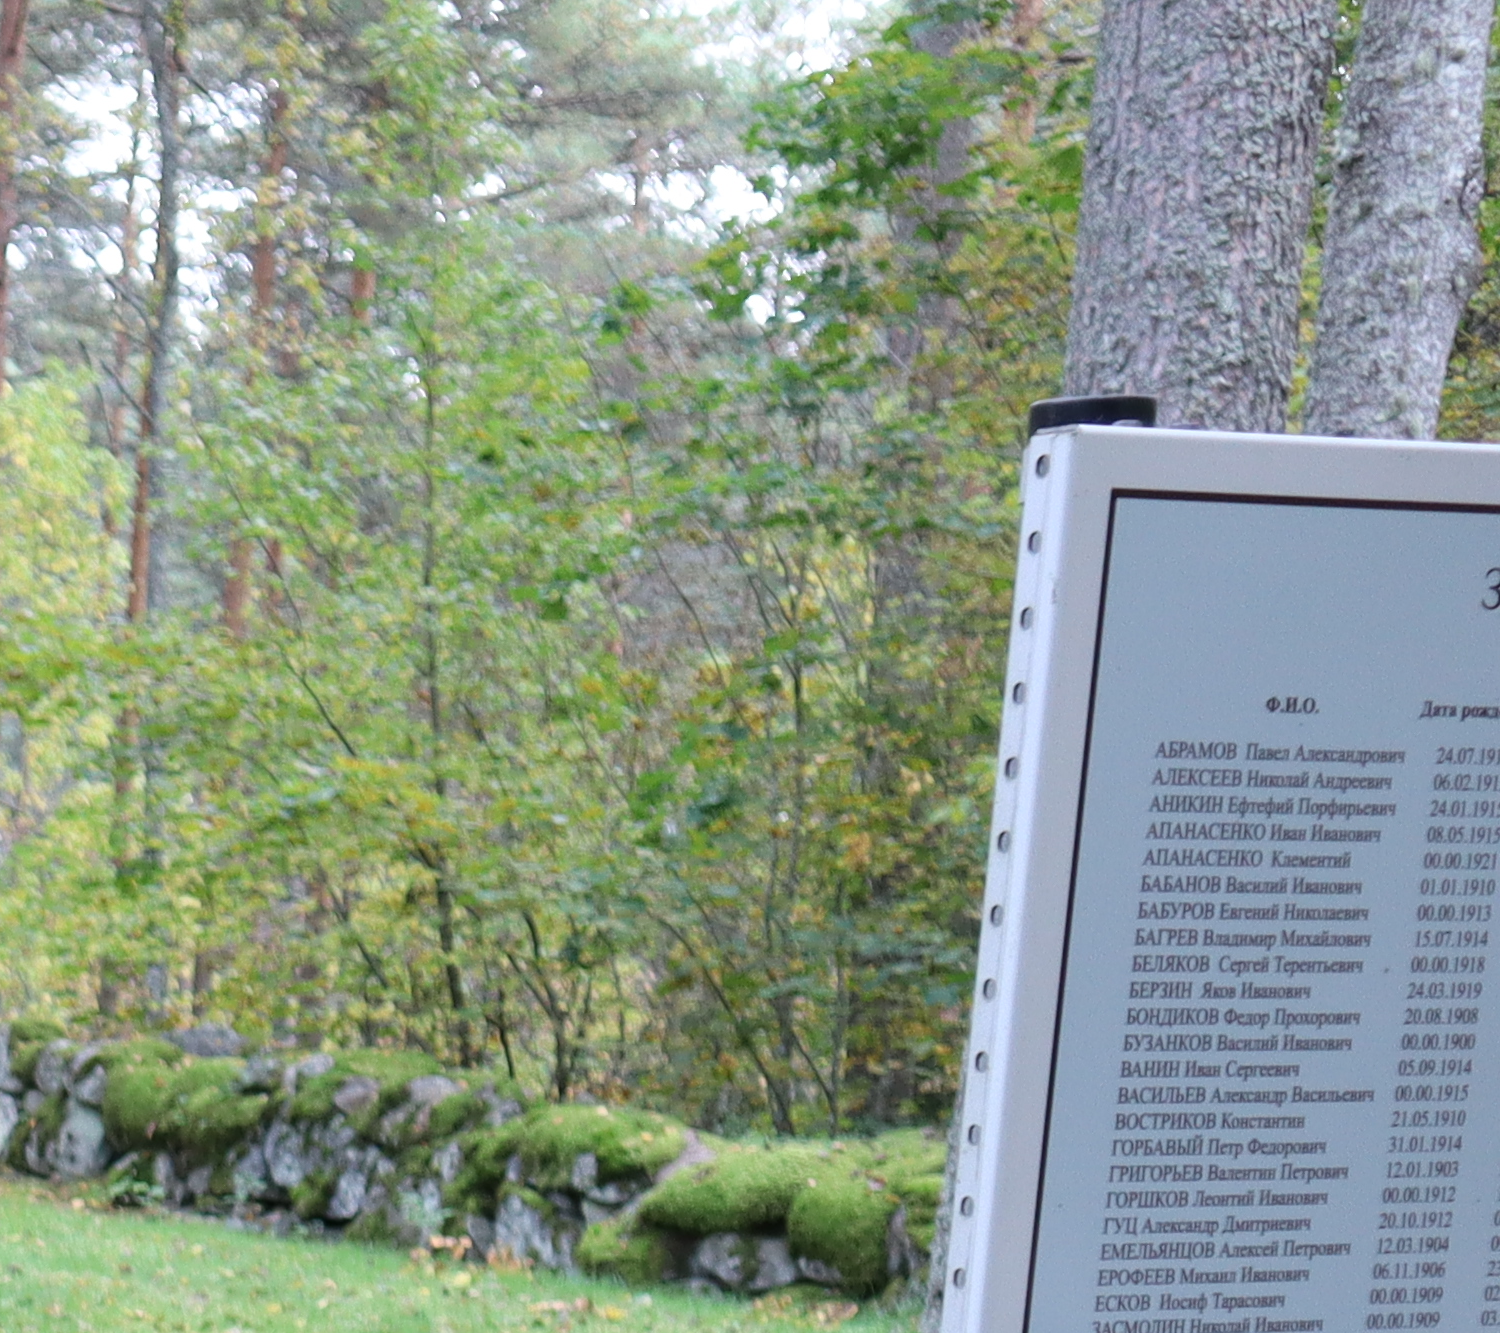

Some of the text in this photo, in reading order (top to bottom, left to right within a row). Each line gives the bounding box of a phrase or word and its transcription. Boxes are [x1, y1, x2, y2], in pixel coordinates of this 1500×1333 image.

[1266, 697, 1456, 719] Ф.И.О. Дата
[1155, 740, 1406, 768] АБРАМОВ Павел Александрович
[1152, 767, 1393, 794] АЛЕКСЕЕВ Николай Андреевич
[1149, 794, 1224, 813] АНИКИН
[1298, 797, 1397, 820] Порфирьевич
[1146, 821, 1267, 841] АПАНАСЕНКО
[1270, 824, 1307, 842] Иван
[1311, 824, 1382, 843] Иванович
[1142, 848, 1498, 871] АПАНАСЕНКО Клементий 00.00.1921
[1140, 874, 1497, 896] БАБАНОВ Василий Иванович 01.01.1910
[1137, 901, 1492, 922] БАБУРОВ Евгений Николаевич 00.00.1913
[1203, 929, 1277, 951] Владимир
[1281, 929, 1372, 948] Михайлович
[1416, 929, 1489, 948] 15.07.1914
[1132, 955, 1486, 978] БЕЛЯКОВ Сергей Терентьевич 00.00.1918
[1129, 981, 1483, 1000] БЕРЗИН Яков Иванович 24.03.1919
[1126, 1007, 1480, 1030] БОНДИКОВ Федор Прохорович 20.08.1908
[1123, 1033, 1477, 1053] БУЗАНКОВ Василий Иванович 00.00.1900
[1120, 1059, 1473, 1082] ВАНИН Иван Сергеевич 05.09.1914
[1117, 1084, 1470, 1108] ВАСИЛЬЕВ Александр Васильевич 00.00.1915
[1115, 1109, 1467, 1131] ВОСТРИКОВ Константин 21.05.1910
[1111, 1135, 1463, 1160] ГОРБАВЫЙ Петр Федорович 31.01.1914
[1109, 1160, 1459, 1185] ГРИГОРЬЕВ Валентин Петрович 12.01.1903
[1106, 1185, 1457, 1209] ГОРШКОВ Леонтий Иванович 00.00.1912
[1102, 1211, 1453, 1237] ГУЦ Александр Дмитриевич 20.10.1912
[1100, 1236, 1450, 1262] ЕМЕЛЬЯНЦОВ Алексей Петрович 12.03.1904
[1097, 1261, 1446, 1287] ЕРОФЕЕВ Михаил Иванович 06.11.1906
[1094, 1294, 1151, 1313] ЕСКОВ
[1213, 1292, 1286, 1313] Тарасович
[1369, 1286, 1444, 1305] 00.00.1909
[1254, 1316, 1324, 1333] Иванович
[1366, 1311, 1441, 1330] 00.00.1909
